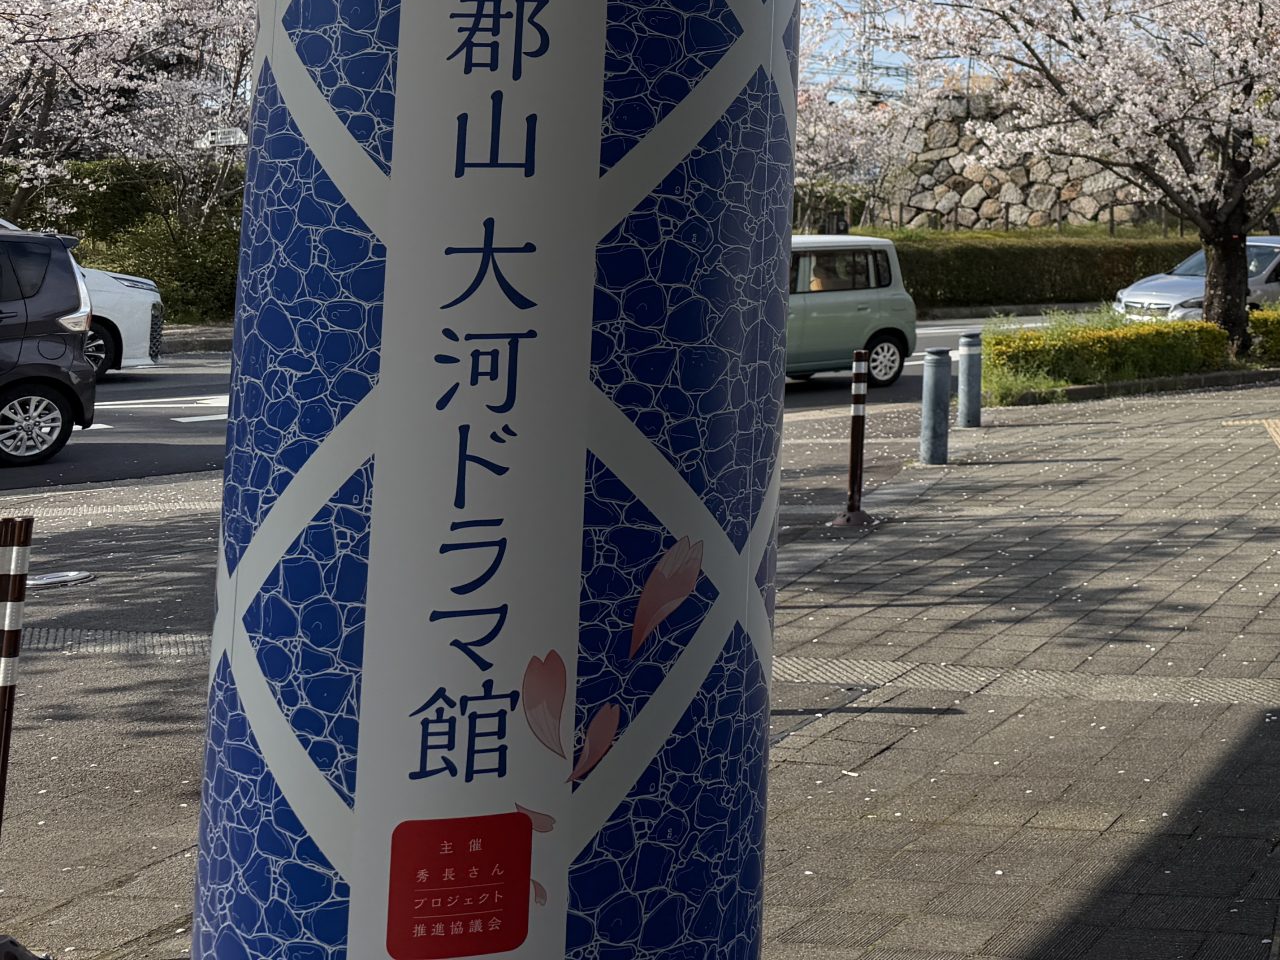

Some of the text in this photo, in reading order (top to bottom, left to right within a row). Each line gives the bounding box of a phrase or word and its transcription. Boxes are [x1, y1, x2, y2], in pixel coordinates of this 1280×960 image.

[439, 838, 483, 855] 主催
[415, 863, 505, 884] 秀長さん
[413, 890, 504, 910] プロジェクト
[412, 916, 503, 938] 推進協議会
